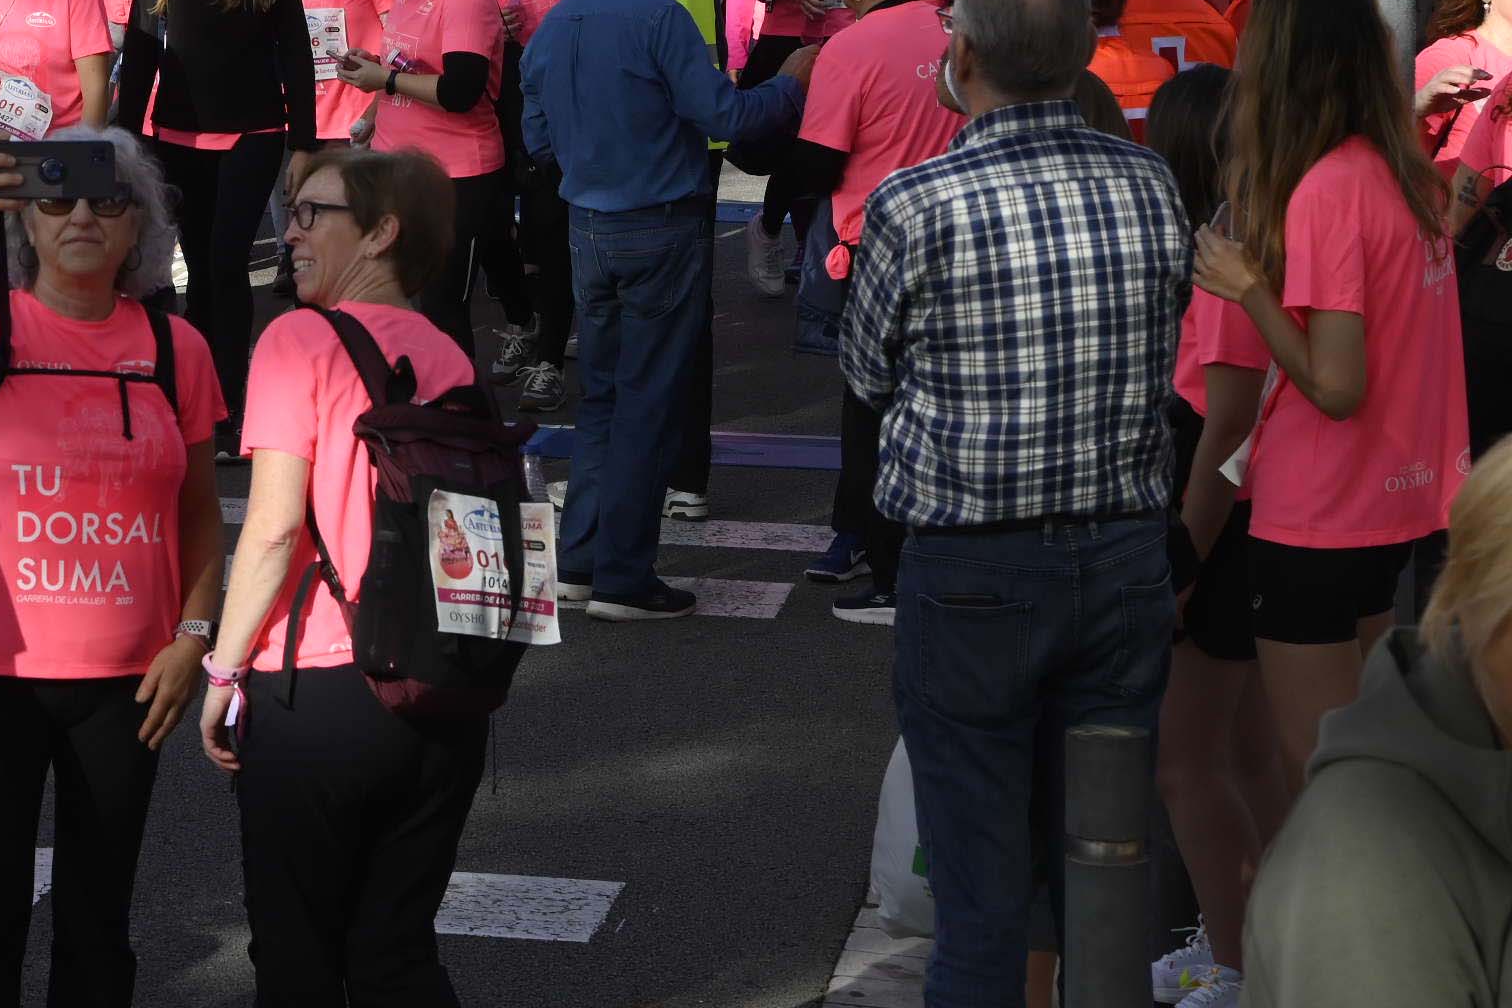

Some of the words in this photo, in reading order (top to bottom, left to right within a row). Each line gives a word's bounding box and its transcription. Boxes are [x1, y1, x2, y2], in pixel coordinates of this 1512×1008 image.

[11, 464, 62, 496] TU
[16, 511, 162, 545] DORSAL
[521, 520, 543, 531] UMA
[477, 549, 507, 573] 01
[16, 557, 131, 594] SUMA
[16, 594, 54, 605] CARRERA
[449, 611, 484, 624] OYSHO
